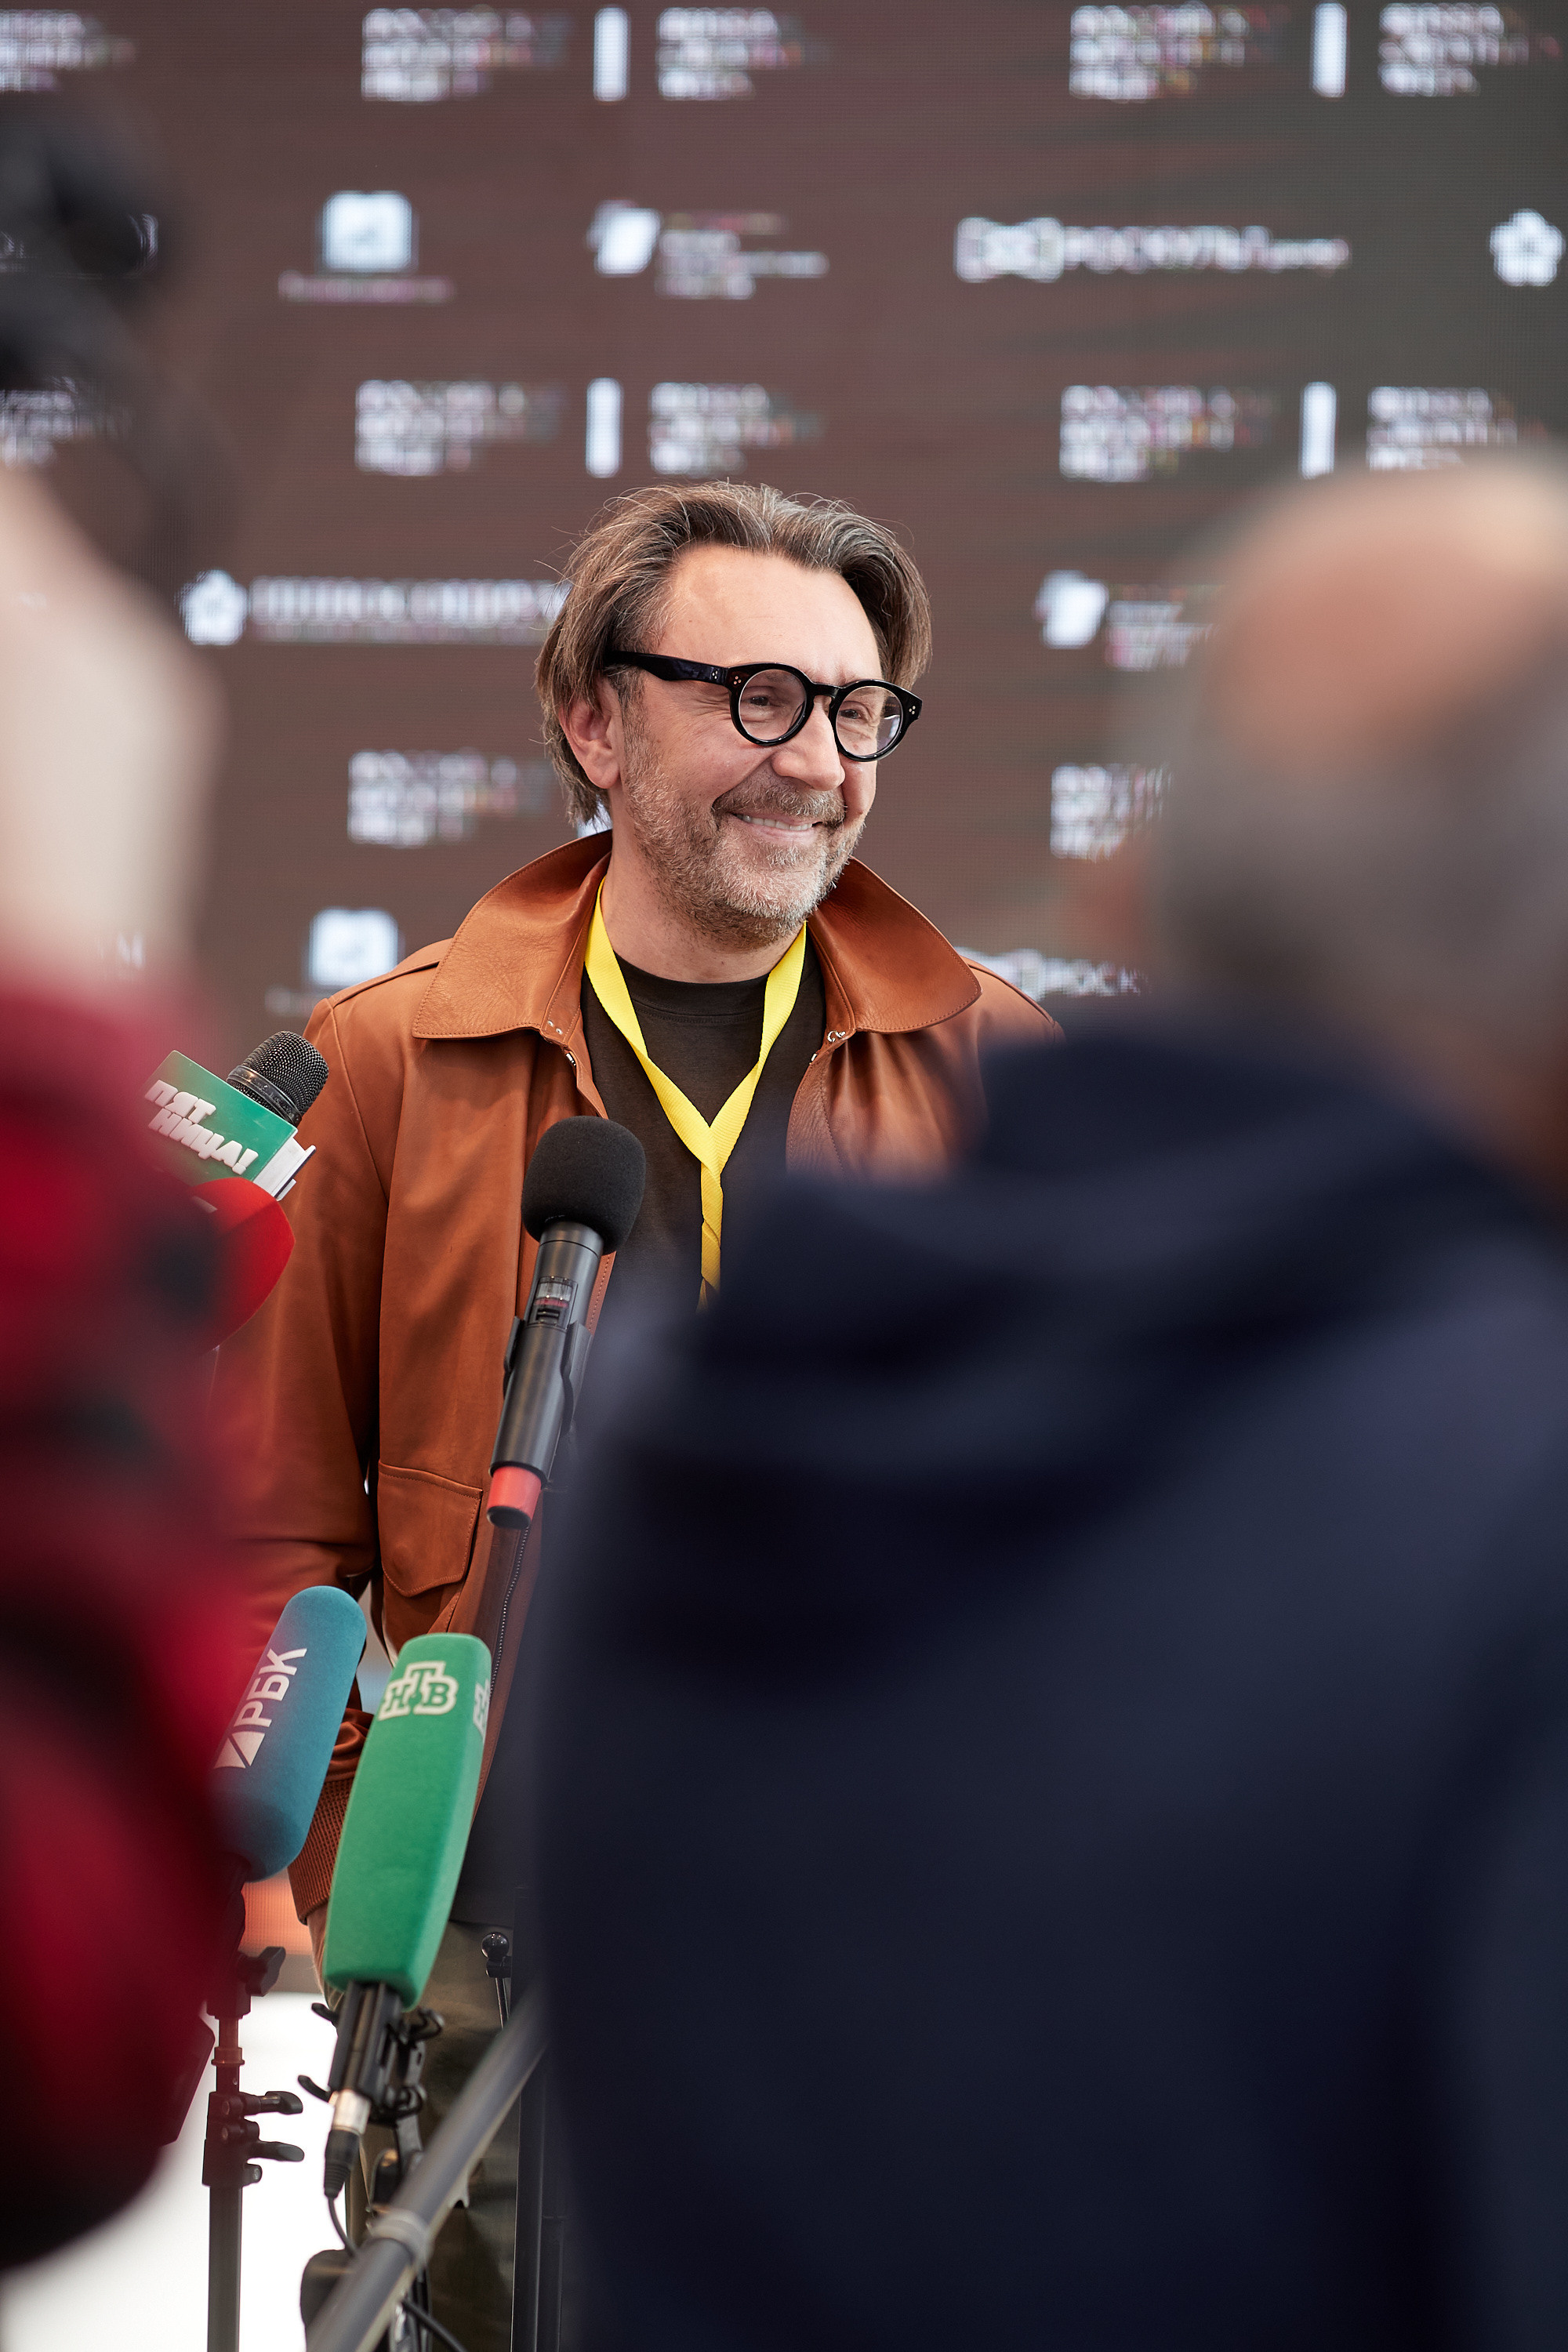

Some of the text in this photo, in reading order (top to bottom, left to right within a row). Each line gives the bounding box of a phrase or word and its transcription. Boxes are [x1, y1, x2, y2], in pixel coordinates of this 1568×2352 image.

[145, 1080, 216, 1124] ПЯТ
[234, 1647, 307, 1728] РБК
[378, 1661, 459, 1721] НТВ
